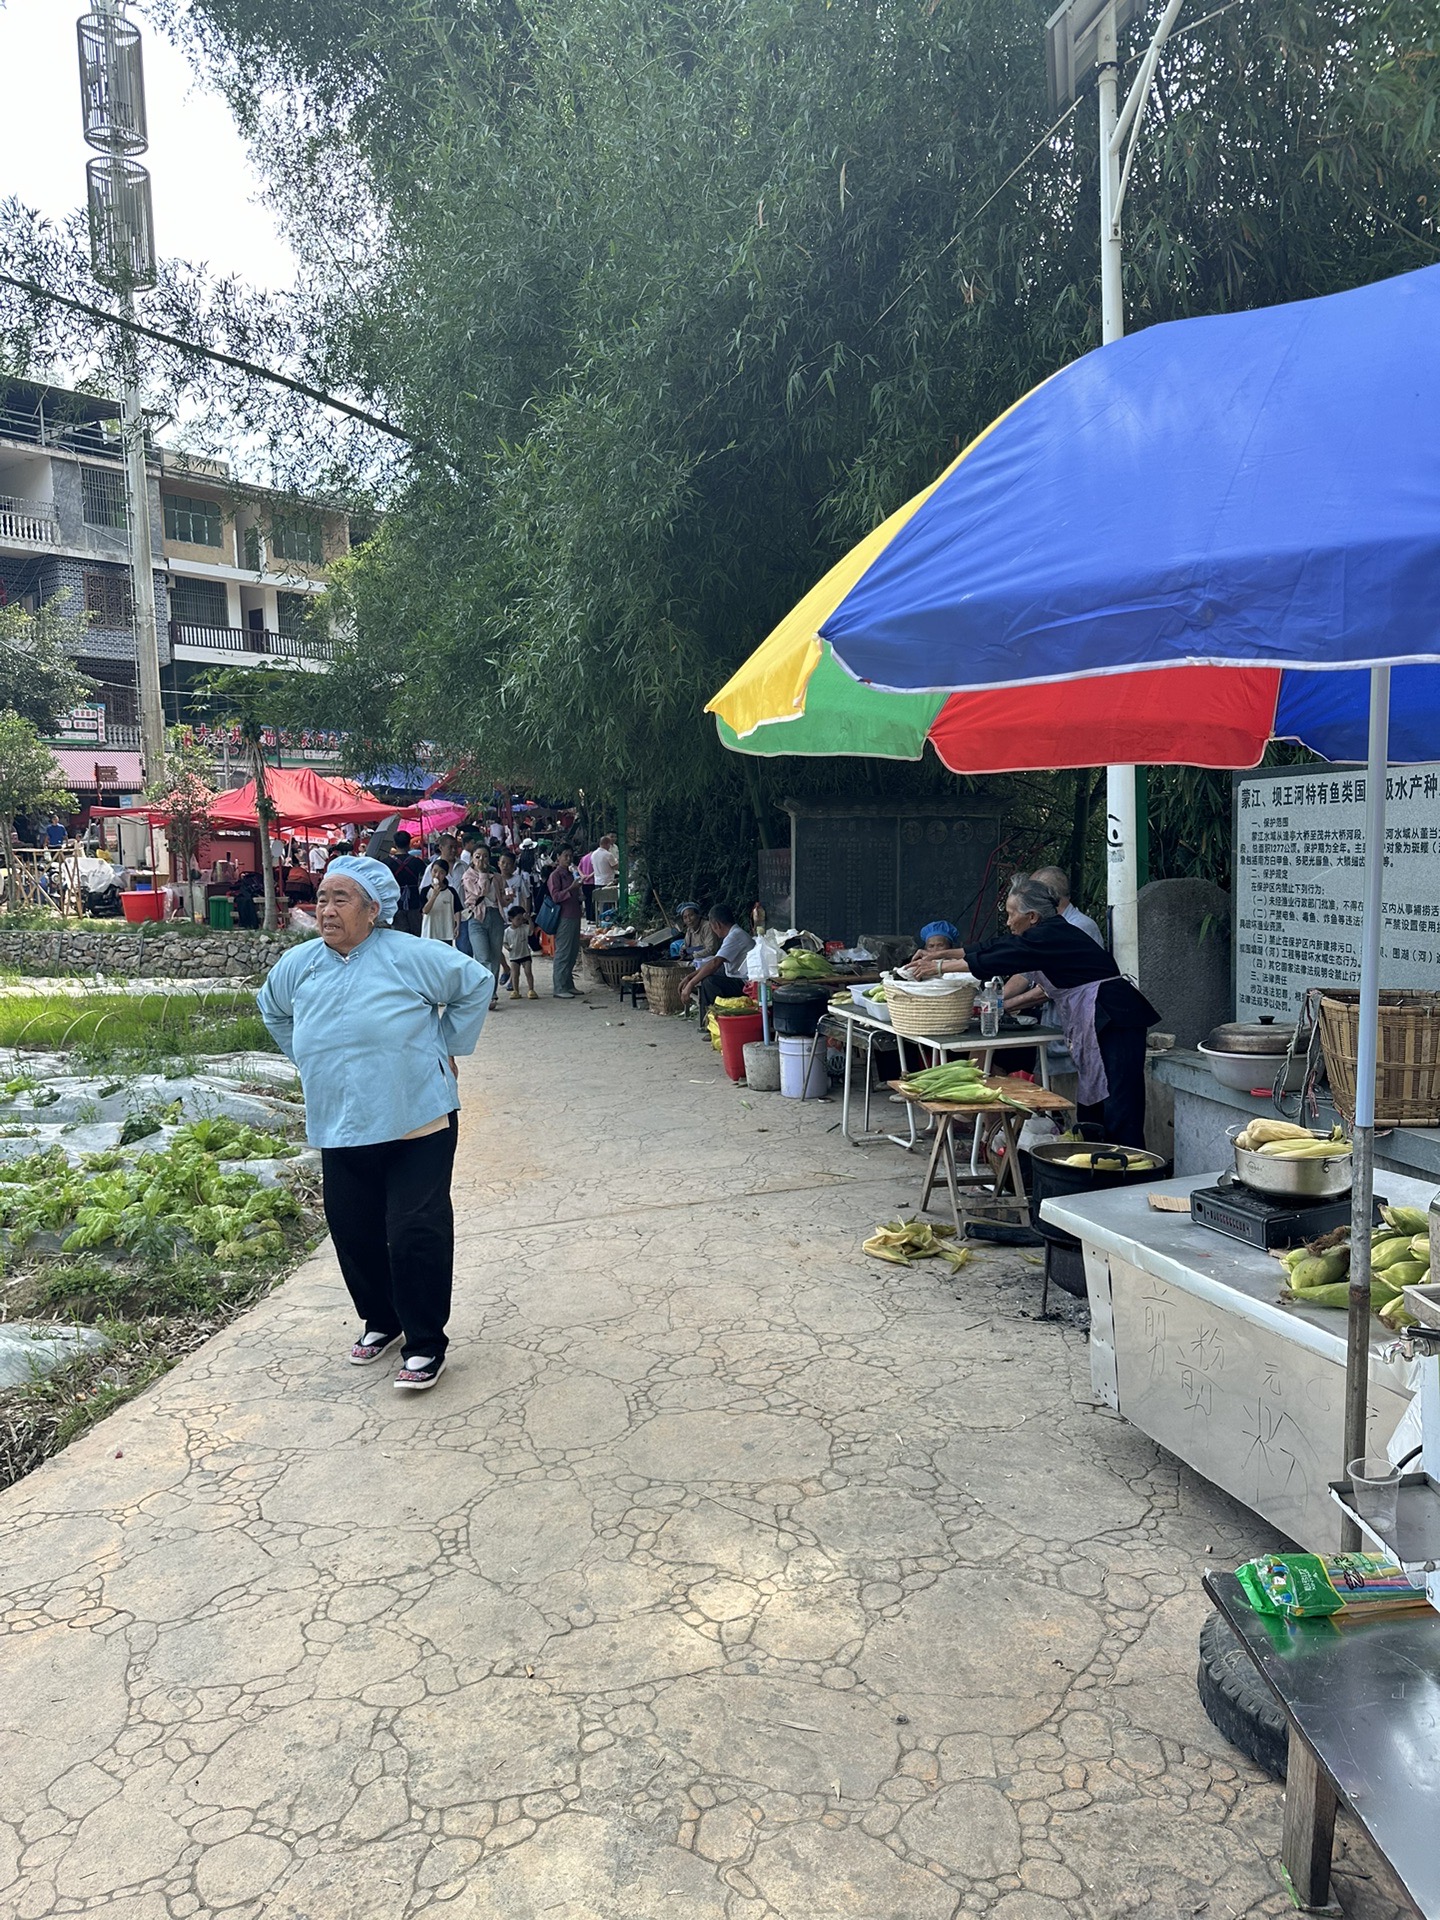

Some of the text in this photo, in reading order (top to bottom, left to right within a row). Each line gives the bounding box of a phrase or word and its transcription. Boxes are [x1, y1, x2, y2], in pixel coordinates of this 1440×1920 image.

[1241, 773, 1440, 809] 蒙江、坝王河特有鱼类国级水产种
